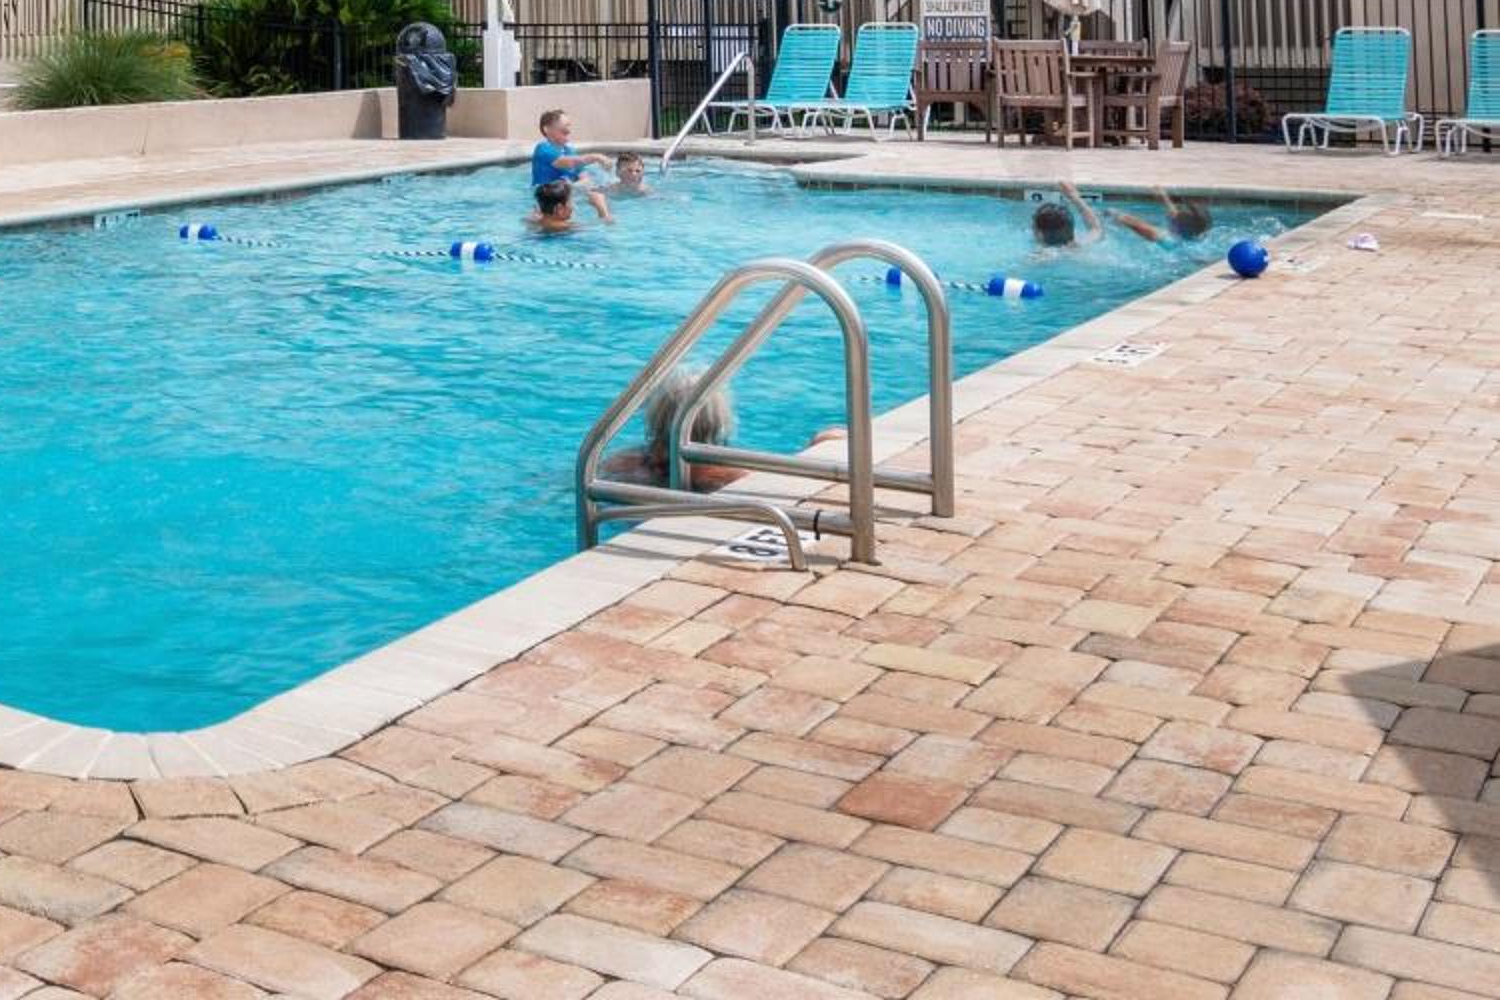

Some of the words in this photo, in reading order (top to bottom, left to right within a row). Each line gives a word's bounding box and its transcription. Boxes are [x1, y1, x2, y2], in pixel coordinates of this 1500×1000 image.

[927, 17, 943, 37] NO
[945, 17, 985, 37] DIVING
[730, 545, 779, 557] 8
